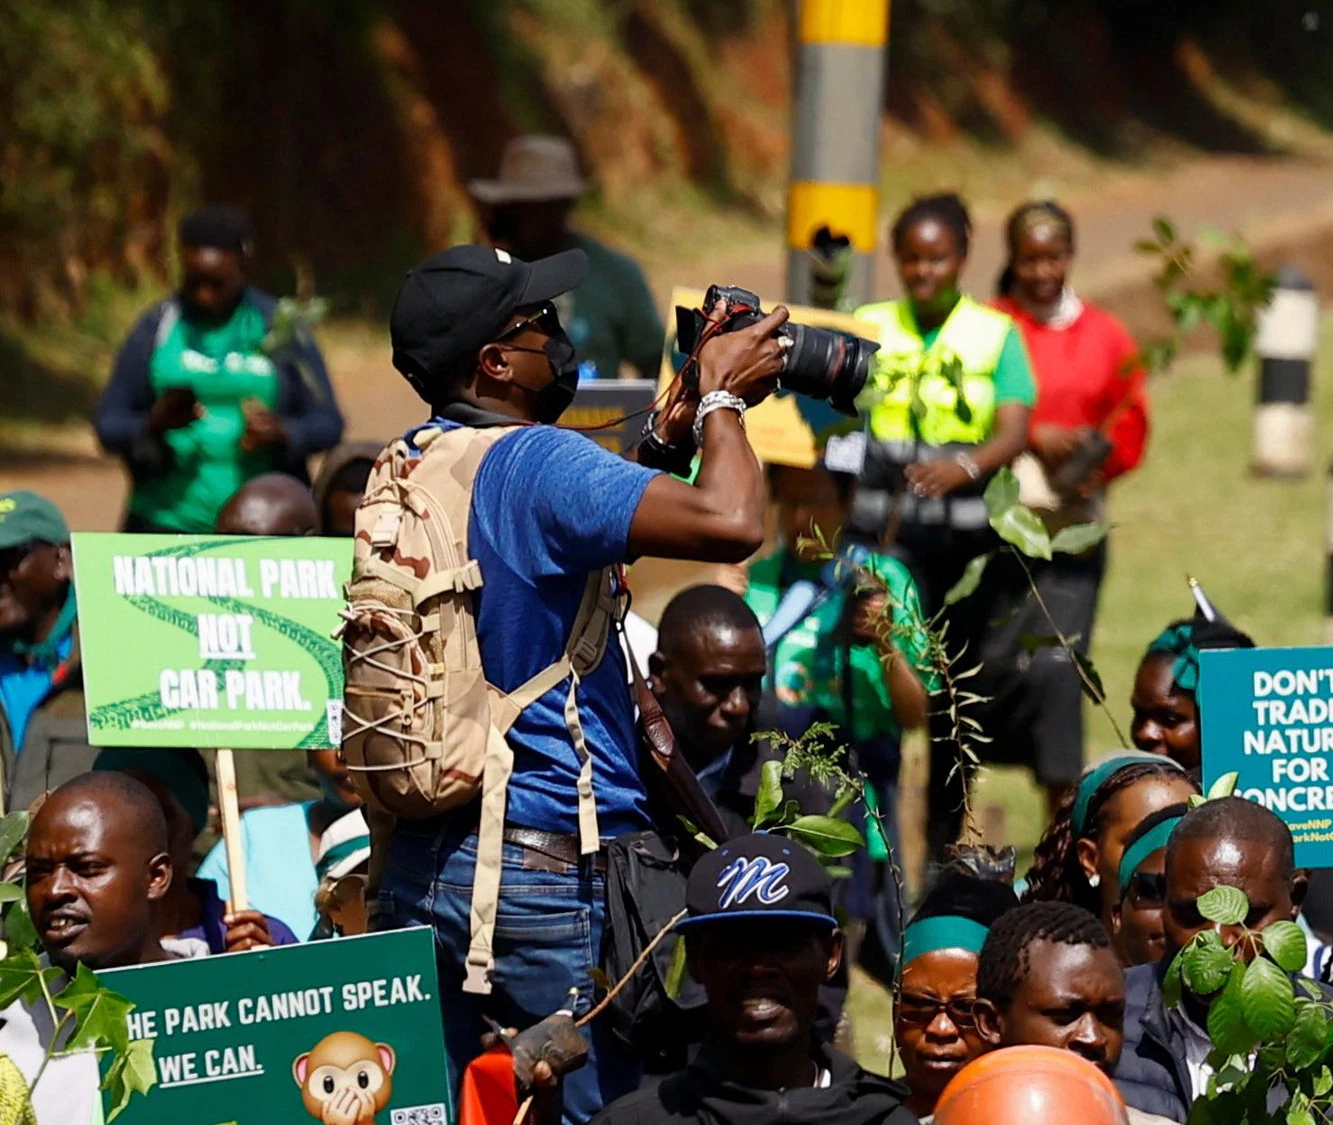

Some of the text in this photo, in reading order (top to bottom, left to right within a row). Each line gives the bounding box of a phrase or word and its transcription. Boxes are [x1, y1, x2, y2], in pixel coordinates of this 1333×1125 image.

[112, 554, 339, 600] NATIONAL PARK
[197, 612, 255, 654] NOT
[159, 669, 313, 712] CAR PARK.
[1271, 757, 1331, 784] FOR
[164, 1000, 231, 1037] PARK
[237, 986, 335, 1027] CANNOT
[342, 973, 432, 1013] SPEAK.
[158, 1044, 264, 1084] WE CAN.
